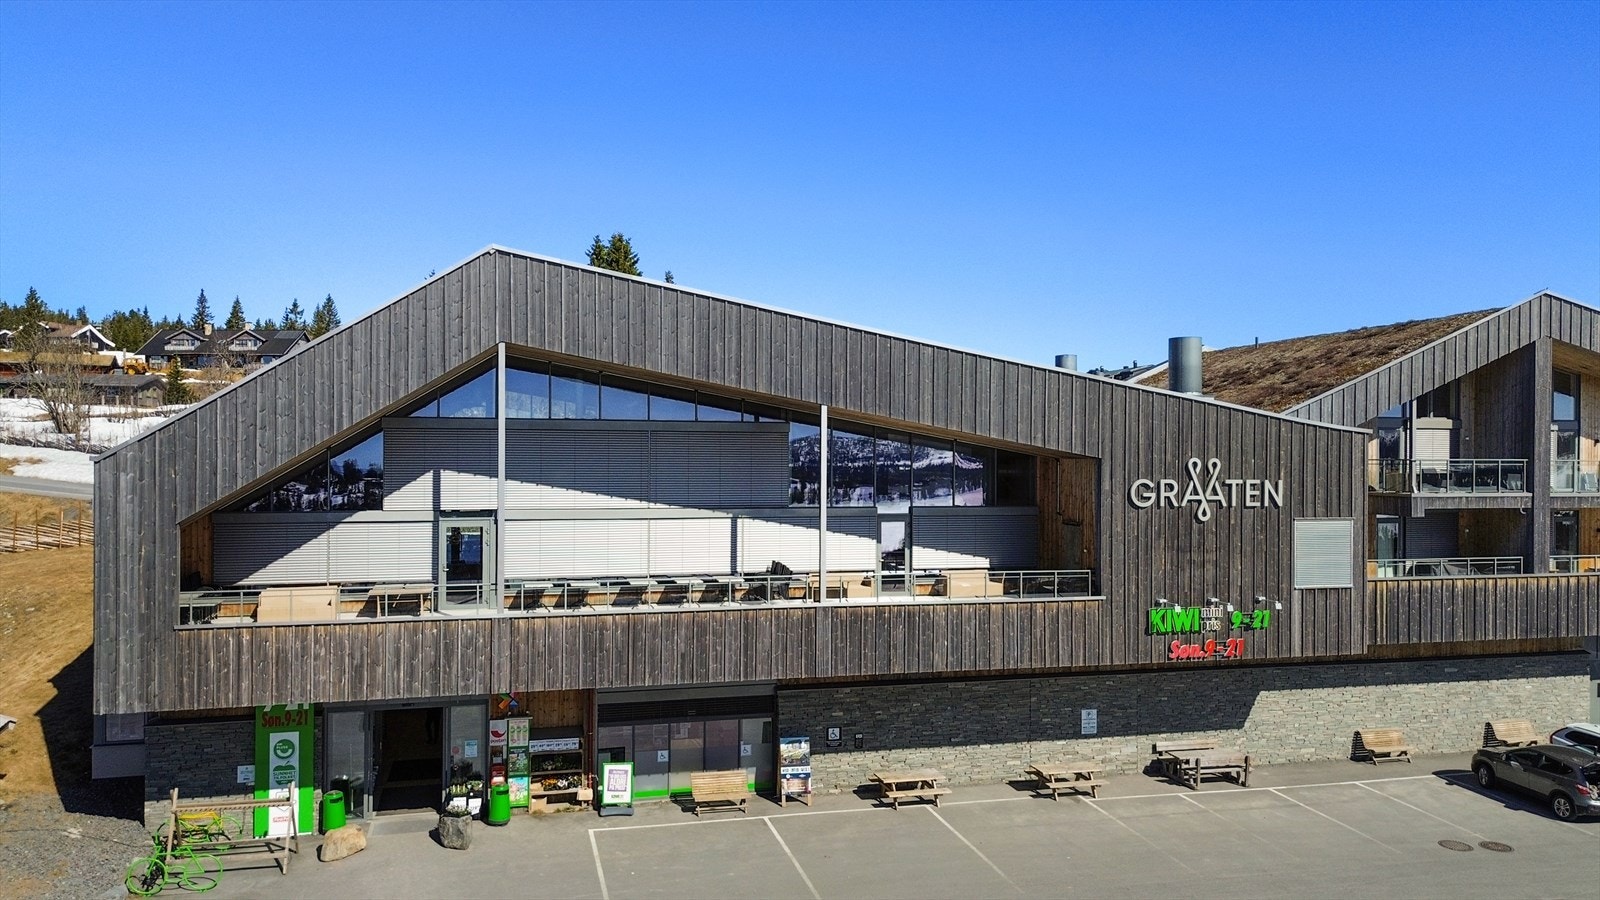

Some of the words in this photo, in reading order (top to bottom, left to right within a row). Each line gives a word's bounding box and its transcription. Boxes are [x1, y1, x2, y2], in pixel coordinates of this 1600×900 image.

[1201, 605, 1224, 618] mini
[1231, 609, 1271, 629] 9-21
[1149, 607, 1201, 634] KIWI
[1201, 618, 1222, 633] pris
